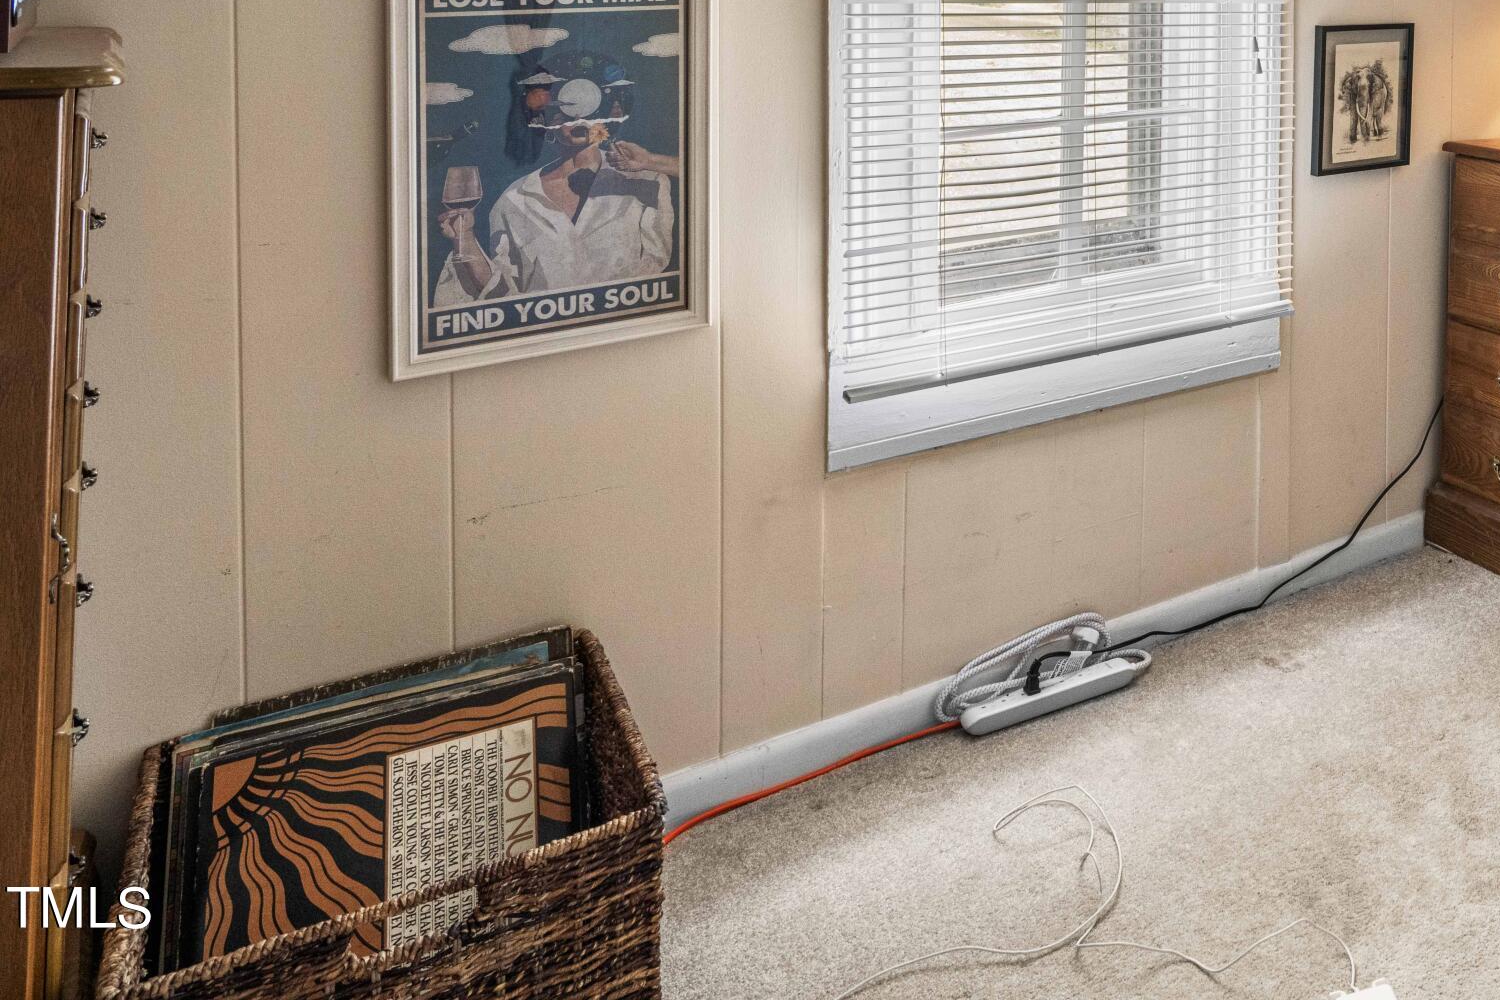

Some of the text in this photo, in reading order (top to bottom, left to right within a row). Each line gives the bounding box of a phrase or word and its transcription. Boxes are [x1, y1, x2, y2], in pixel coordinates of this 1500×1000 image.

[436, 280, 674, 337] FIND YOUR SOUL
[393, 758, 404, 776] GIL
[405, 760, 416, 787] JESSE
[434, 753, 445, 776] TOM
[447, 746, 458, 776] CARLY
[461, 750, 472, 784] BRUCE
[505, 752, 532, 802] NO
[406, 789, 417, 820] COLIN
[420, 762, 431, 821] NICOLETTE
[434, 778, 445, 809] PETTY
[447, 779, 458, 813] SIMON
[487, 739, 499, 860] THE DOOBIE BROTHERS
[435, 819, 445, 841] THE
[461, 783, 472, 850] SPRINGSTEEN
[406, 823, 417, 861] YOUNG
[420, 823, 431, 862] LARSON
[448, 819, 459, 866] GRAHAM
[475, 825, 485, 848] AND
[391, 855, 402, 890] SWEET
[405, 866, 416, 880] RY
